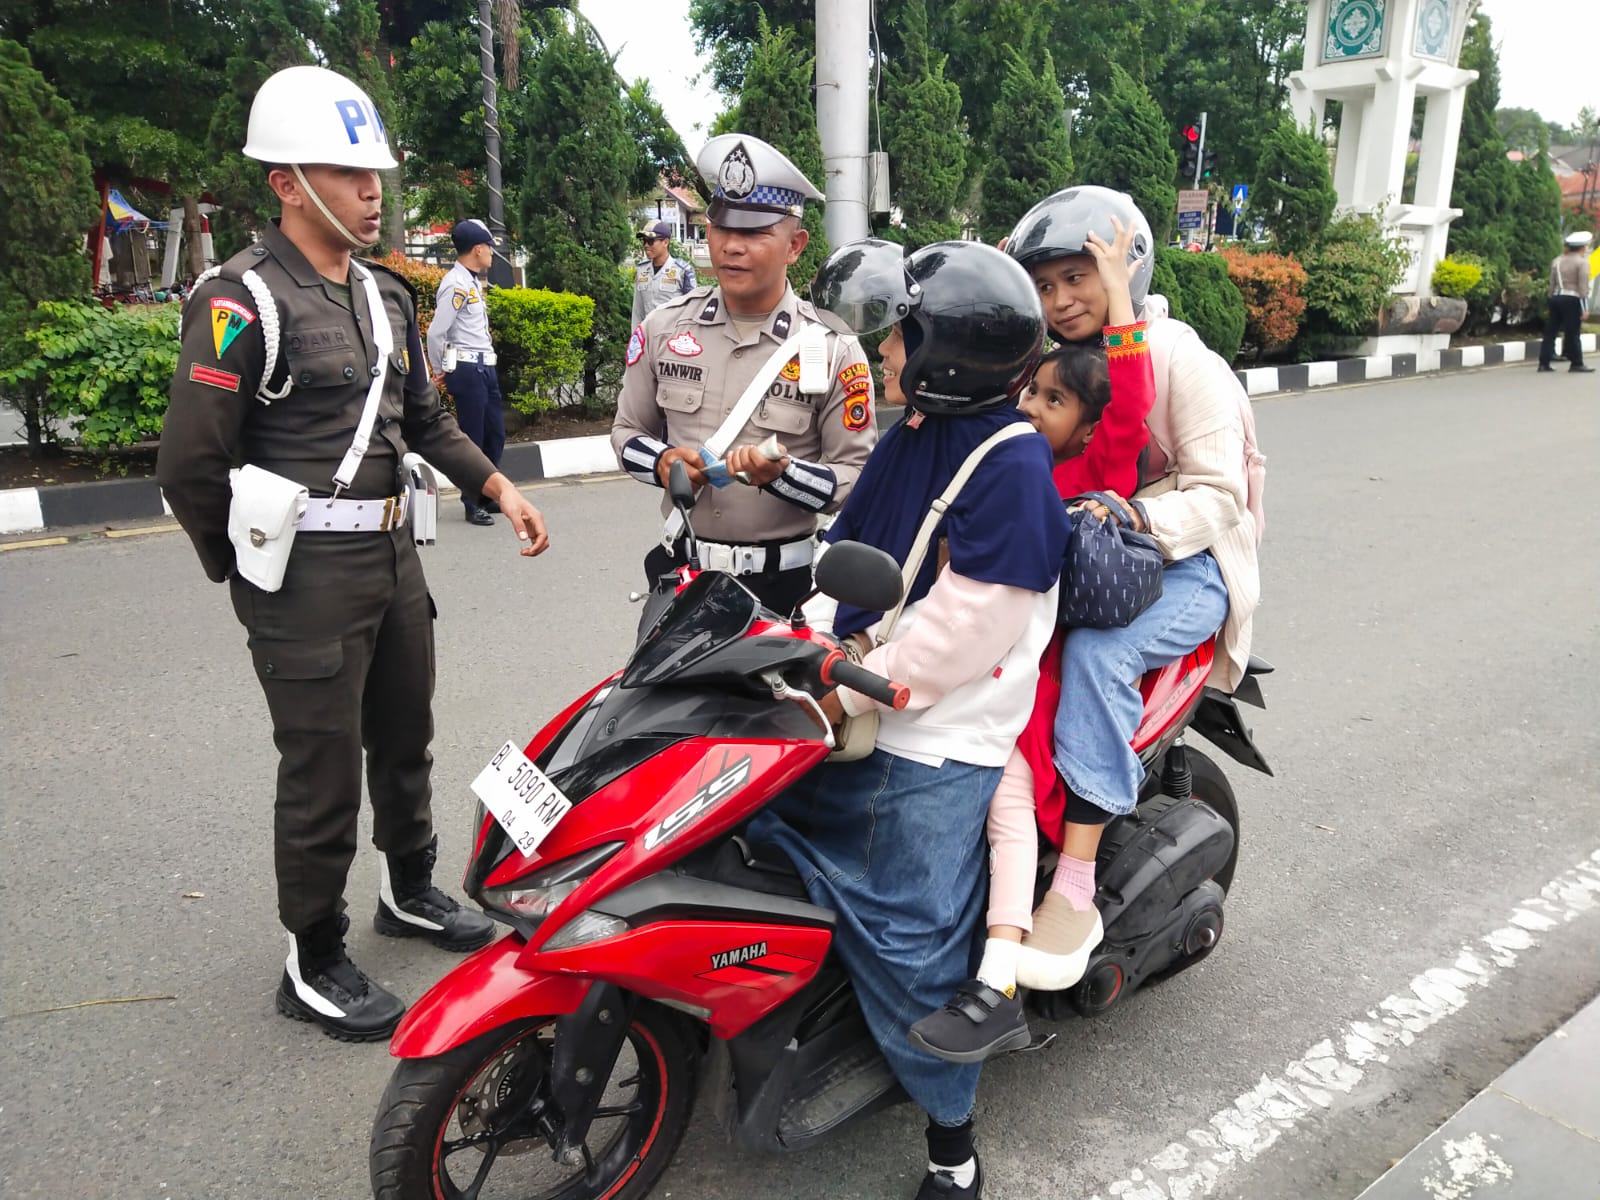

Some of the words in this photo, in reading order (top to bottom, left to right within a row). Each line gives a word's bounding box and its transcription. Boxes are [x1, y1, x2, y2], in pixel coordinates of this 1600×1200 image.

[216, 310, 242, 331] PM
[658, 361, 703, 382] TANWIR
[849, 382, 867, 391] ACEH
[491, 744, 513, 771] BL
[508, 762, 546, 804] 5090
[534, 792, 566, 827] RM
[502, 810, 516, 828] 04
[518, 831, 535, 850] 29
[711, 941, 768, 969] YAMAHA
